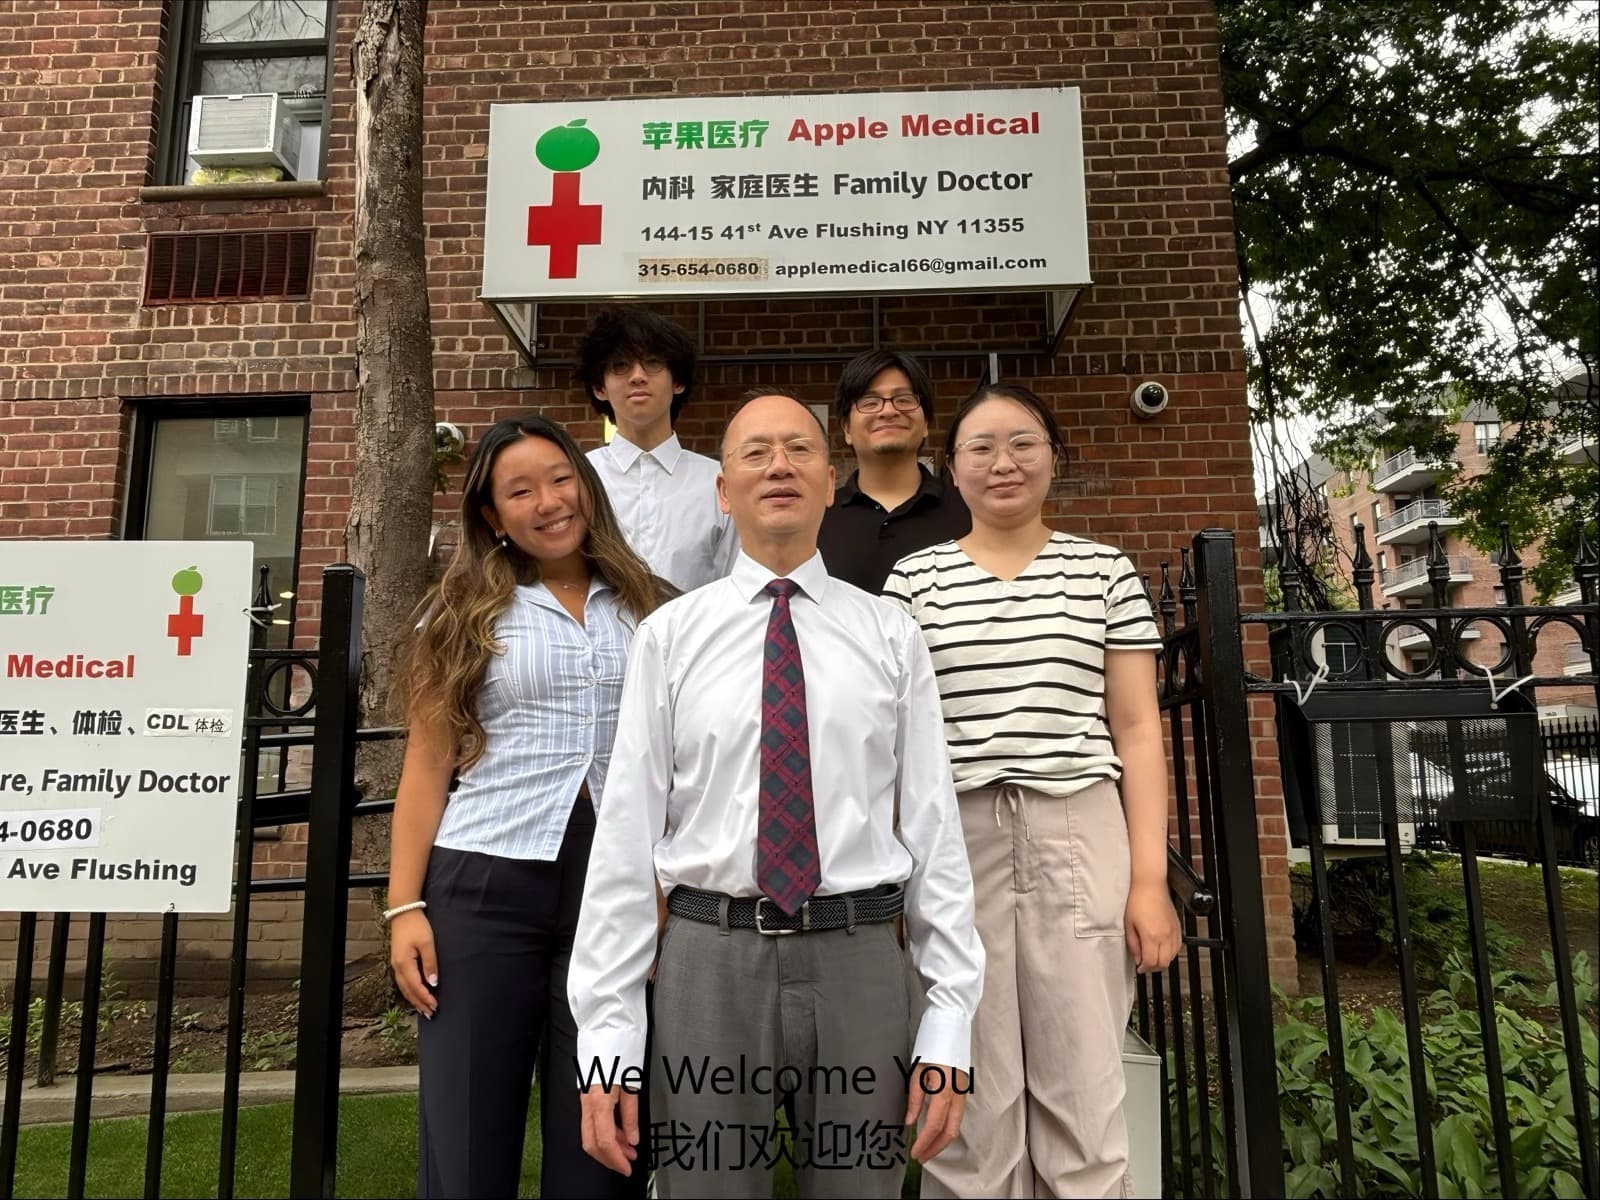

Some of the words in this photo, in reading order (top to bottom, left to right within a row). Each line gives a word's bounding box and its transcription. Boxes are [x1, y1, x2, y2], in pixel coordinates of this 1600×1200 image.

[642, 119, 770, 150] 苹果医疗
[787, 117, 888, 147] Apple
[901, 111, 1040, 137] Medical
[642, 175, 695, 200] 内科
[710, 173, 819, 199] 家庭医生
[833, 171, 928, 199] Family
[937, 170, 1033, 192] Doctor
[640, 226, 714, 241] 144-15
[720, 223, 761, 240] 41st
[768, 224, 808, 240] Ave
[816, 222, 908, 239] Flushing
[917, 219, 949, 235] NY
[957, 217, 1025, 234] 11355
[638, 262, 759, 277] 315-654-0680
[775, 257, 1047, 278] applemedical66@gmail.com
[0, 585, 56, 615] 医疗
[7, 654, 135, 678] Medical
[146, 714, 189, 730] CDL
[194, 717, 225, 733] 体检
[41, 768, 132, 799] Family
[138, 770, 231, 793] Doctor
[7, 858, 60, 880] Ave
[70, 858, 197, 887] Flushing
